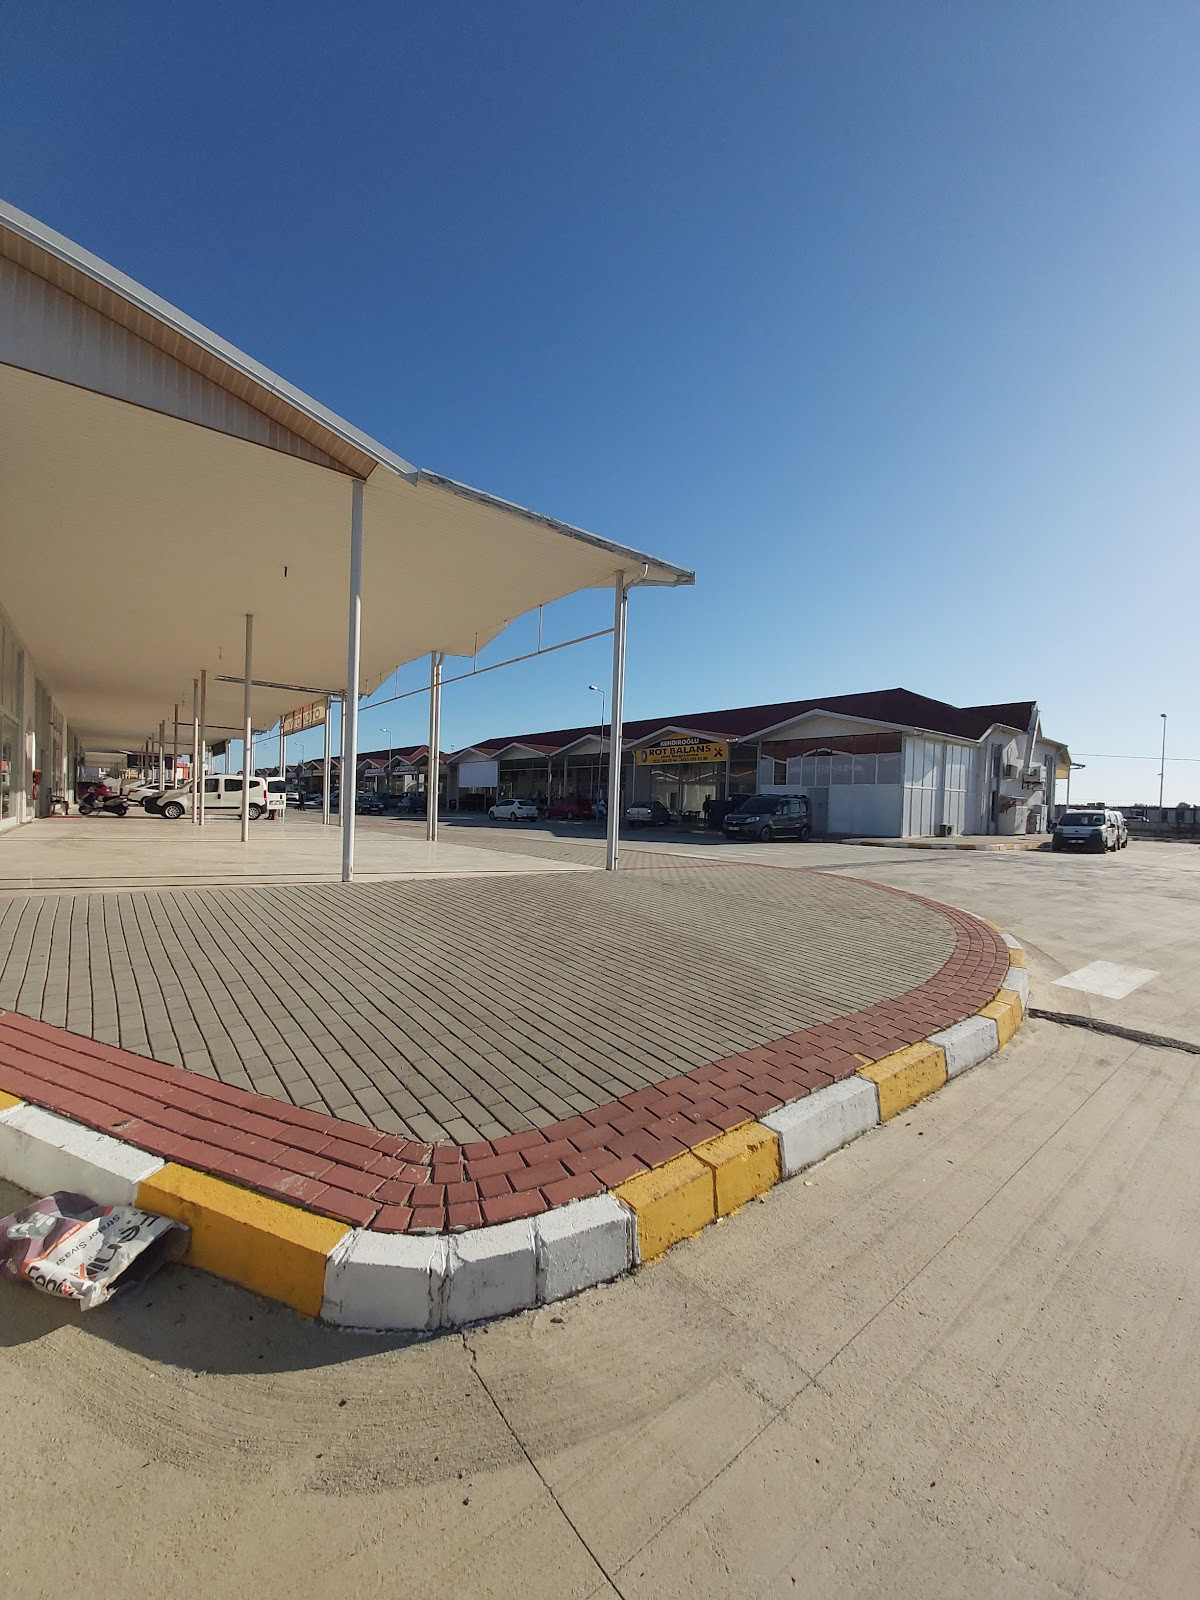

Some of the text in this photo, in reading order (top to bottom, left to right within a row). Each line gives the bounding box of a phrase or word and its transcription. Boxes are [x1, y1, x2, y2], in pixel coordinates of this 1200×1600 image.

[649, 745, 711, 756] ROT BALANS
[88, 1214, 120, 1242] Strafor
